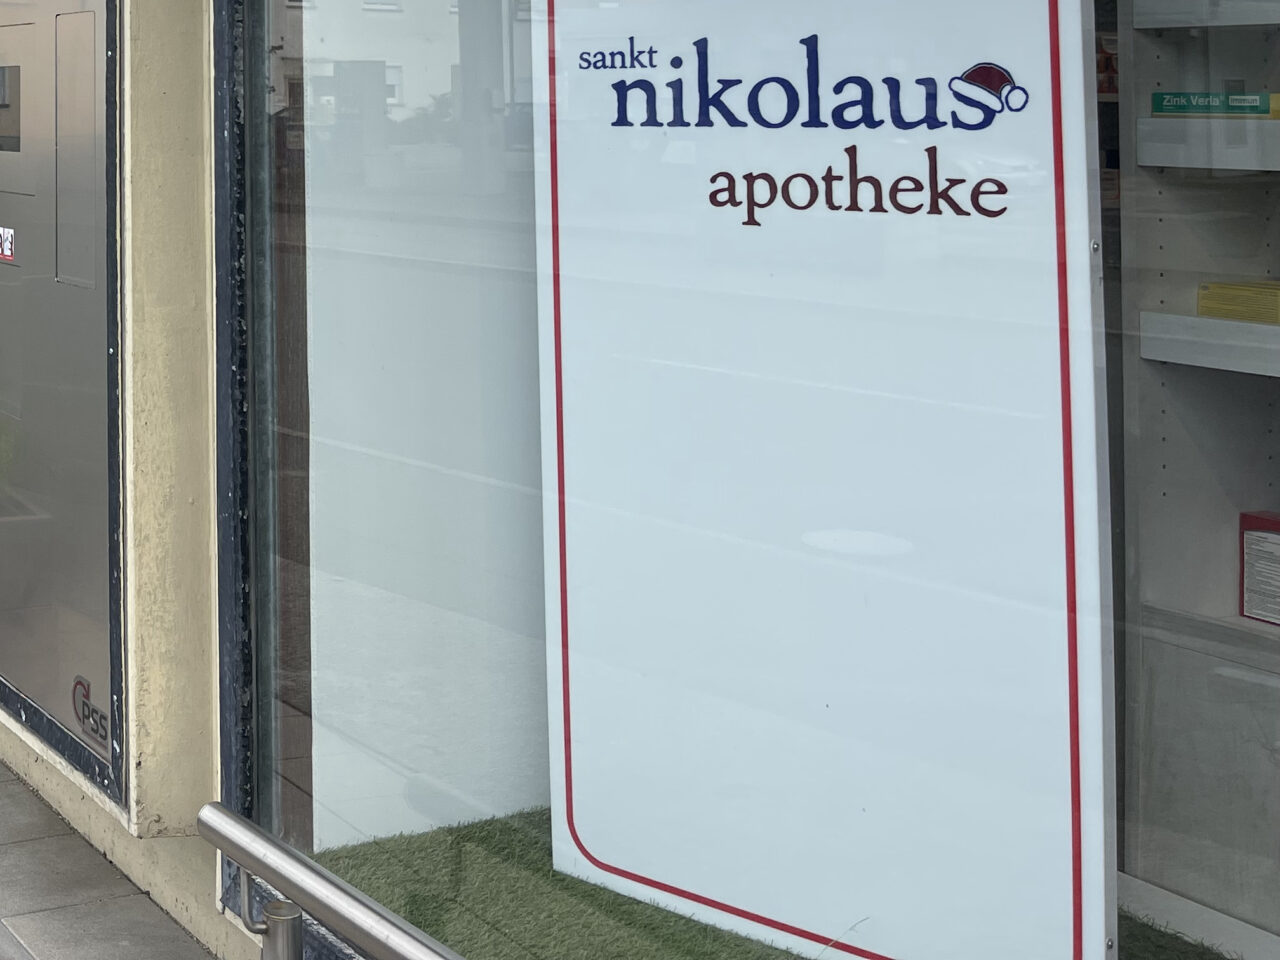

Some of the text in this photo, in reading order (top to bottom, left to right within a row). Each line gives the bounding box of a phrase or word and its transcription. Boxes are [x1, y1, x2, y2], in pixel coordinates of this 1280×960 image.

[578, 36, 658, 70] sankt
[611, 34, 998, 130] nikolaus
[1163, 95, 1187, 106] Zink
[1190, 95, 1220, 106] Verla
[708, 144, 1008, 226] apotheke
[82, 700, 108, 740] PSS
